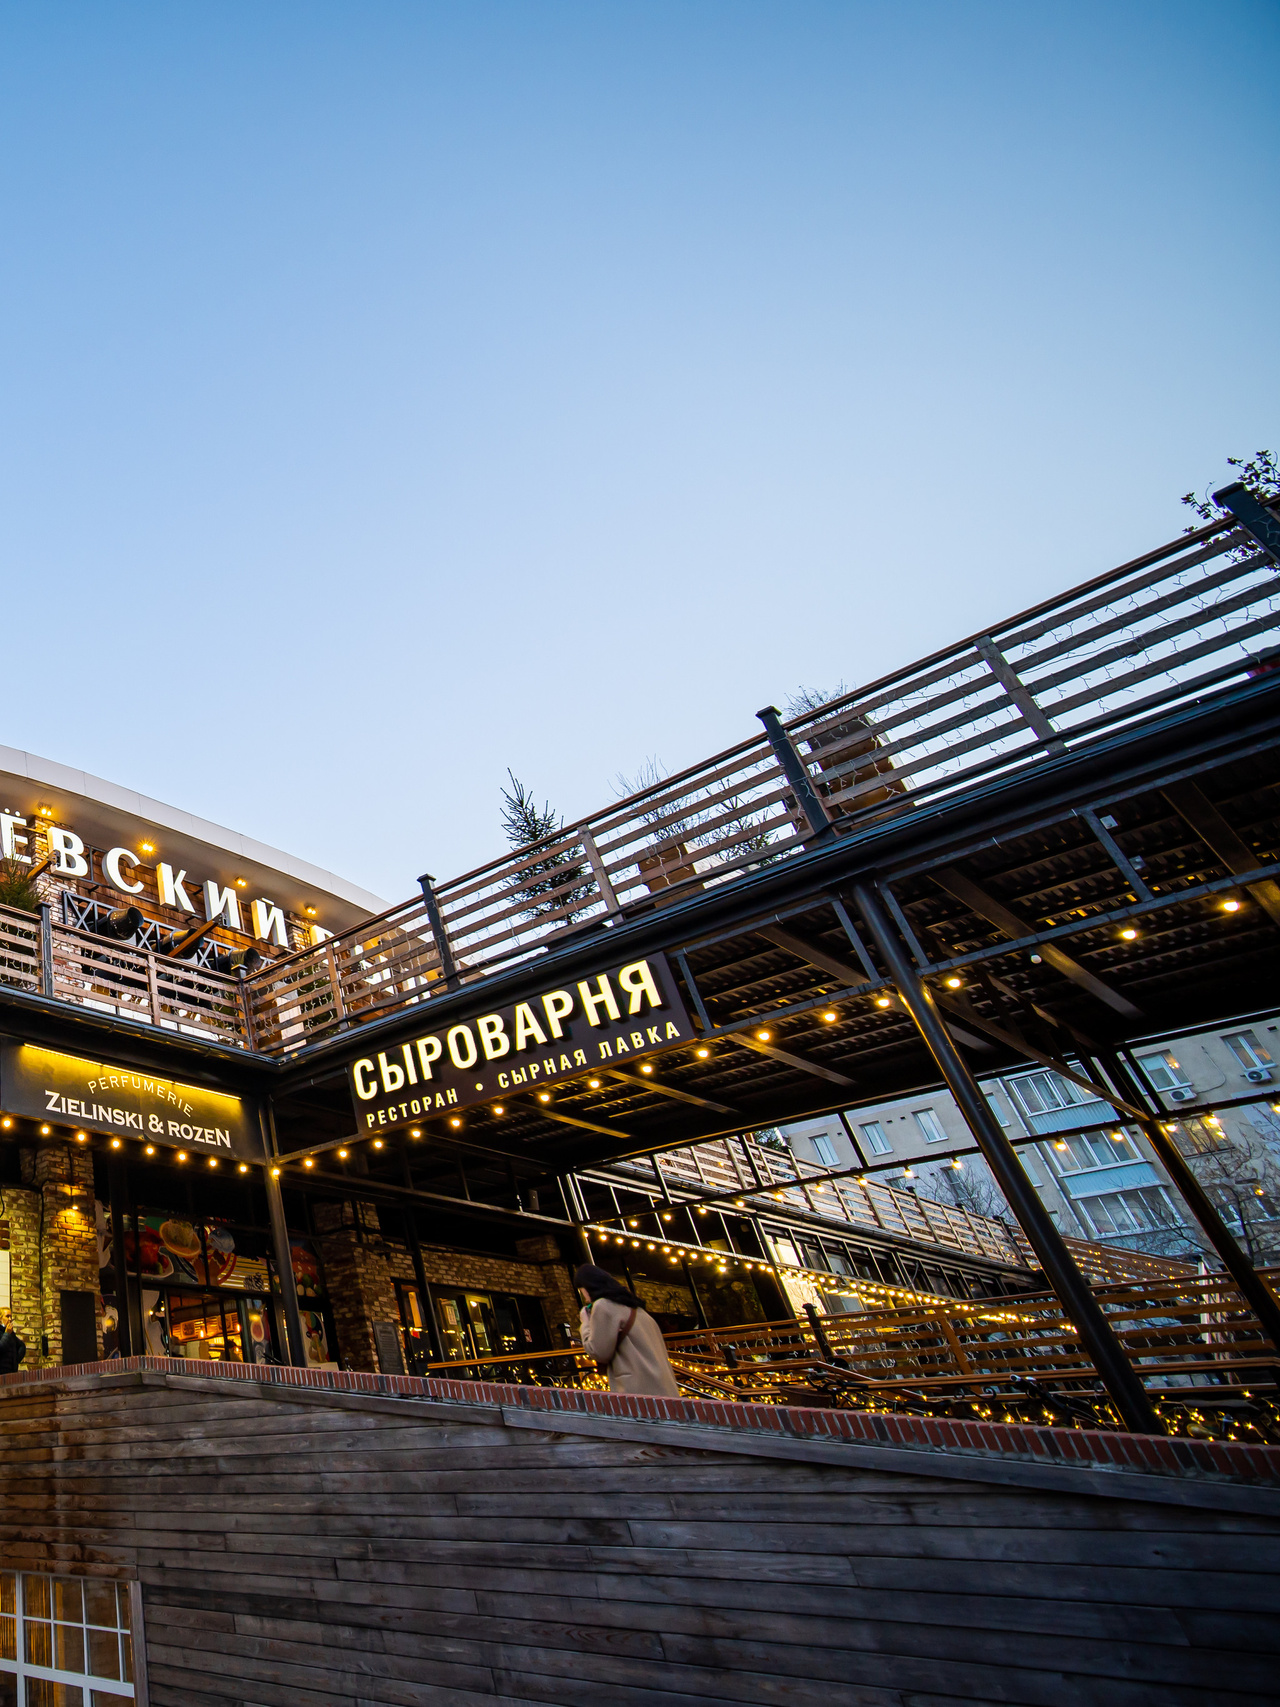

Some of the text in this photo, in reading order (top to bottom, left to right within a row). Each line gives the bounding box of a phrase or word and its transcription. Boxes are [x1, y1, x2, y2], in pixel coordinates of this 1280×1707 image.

[352, 960, 663, 1101] СЫРОВАРНЯ
[87, 1075, 194, 1118] PERFUMERIE
[366, 1021, 681, 1128] РЕСТОРАН СЫРНАЯ ЛАВКА
[45, 1090, 232, 1149] ZIELINSKI & ROZEN
